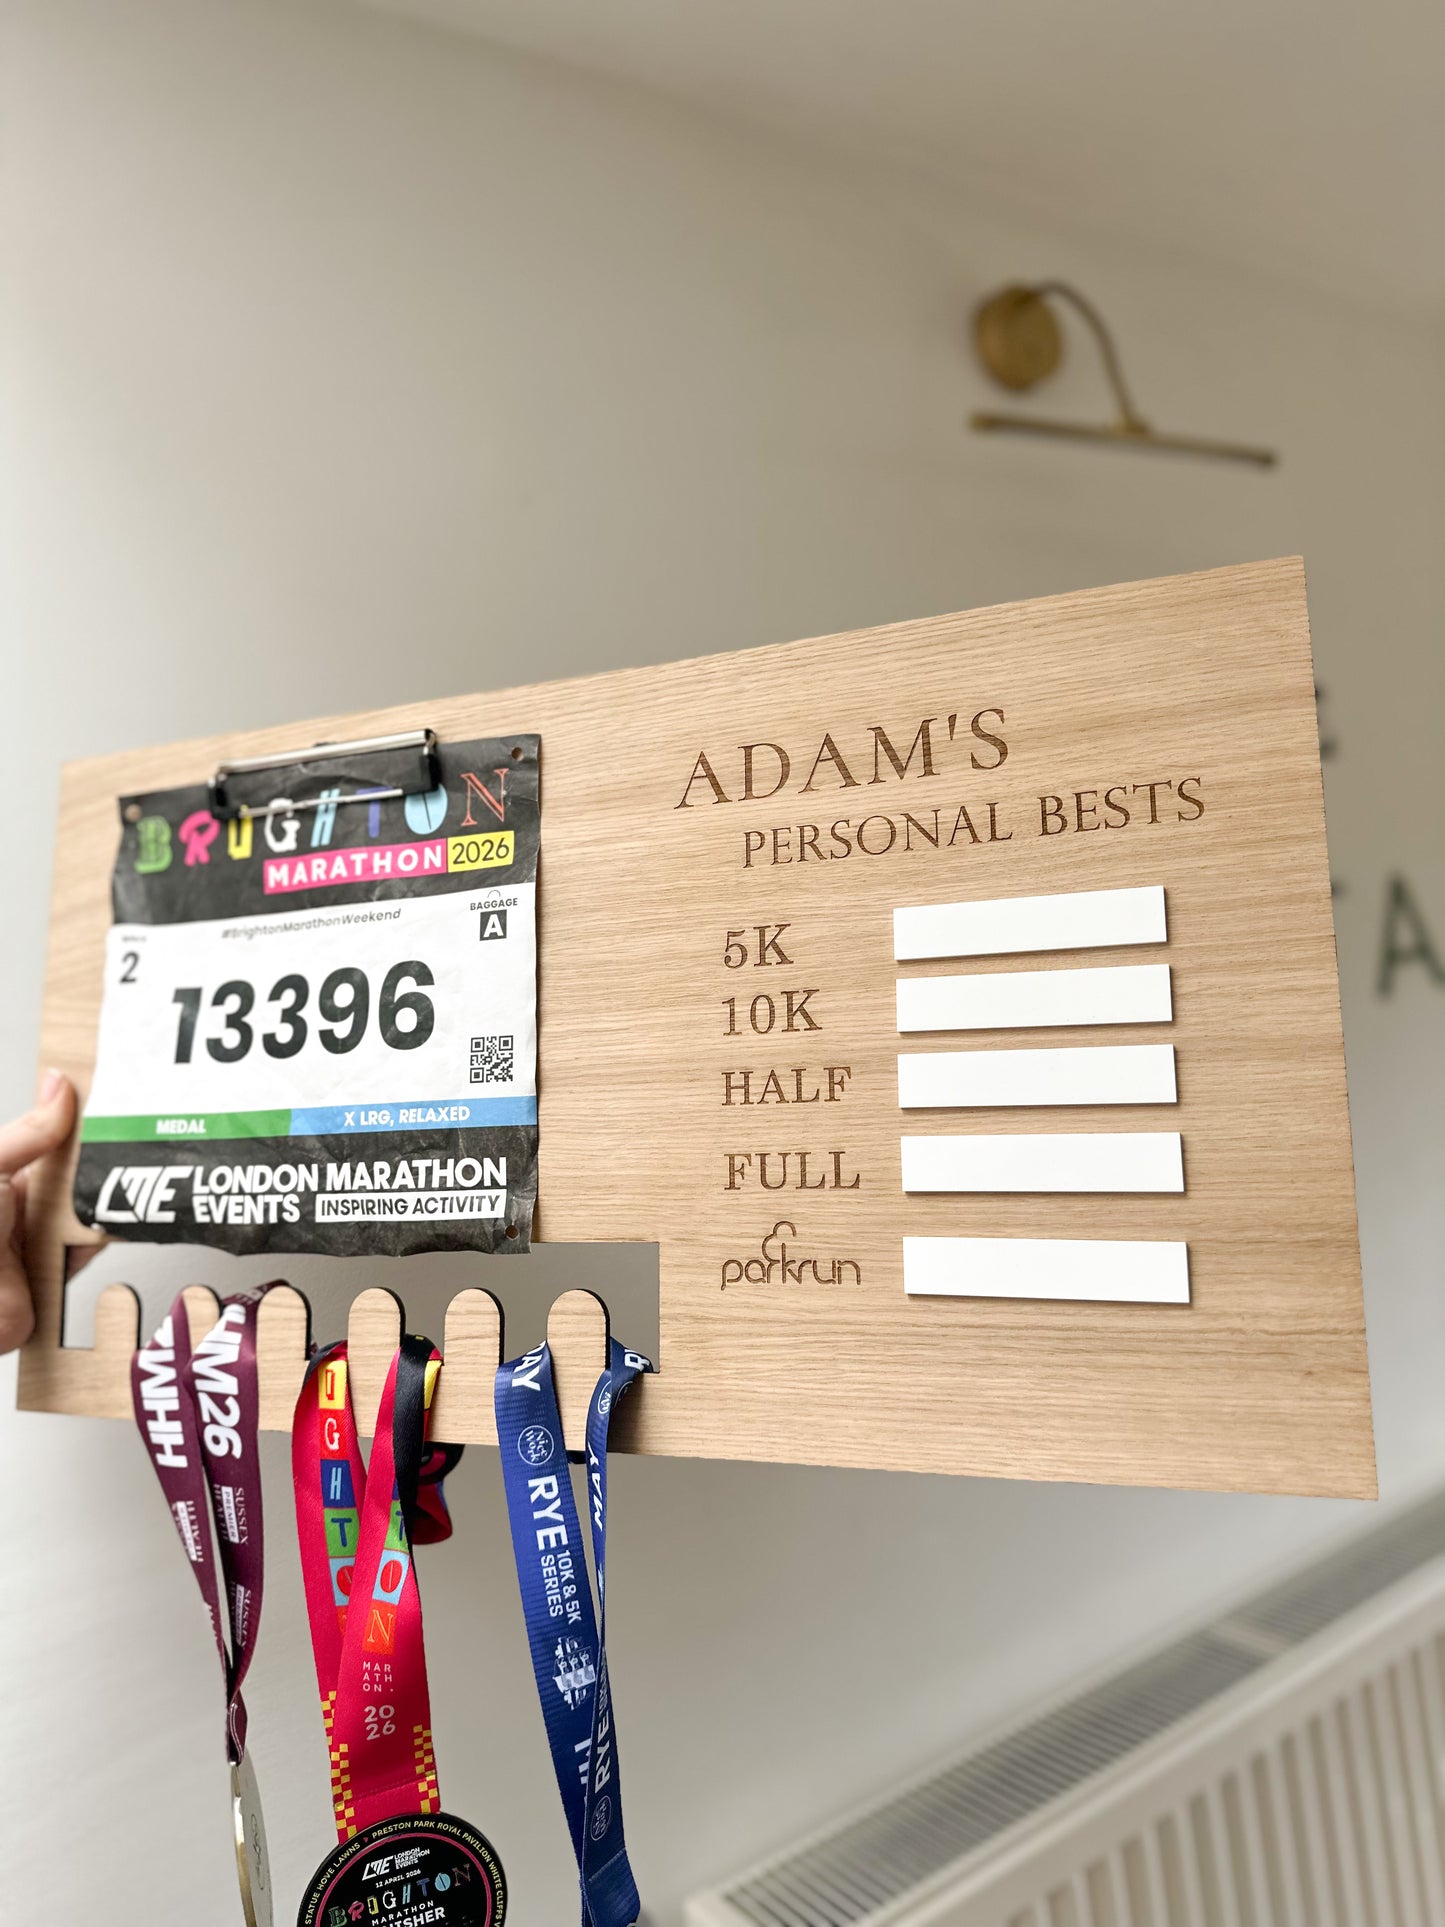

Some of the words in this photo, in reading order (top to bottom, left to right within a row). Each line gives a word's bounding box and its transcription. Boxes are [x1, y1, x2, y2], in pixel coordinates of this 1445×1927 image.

[674, 708, 1010, 810] ADAM'S
[742, 802, 1013, 868] PERSONAL
[1036, 777, 1206, 837] BESTS
[267, 845, 443, 889] MARATHON
[452, 838, 510, 865] 2026
[470, 898, 518, 911] BAGGAGE
[483, 914, 504, 938] A
[722, 923, 795, 969] 5K
[120, 950, 140, 984] 2
[172, 960, 435, 1064] 13396
[721, 988, 823, 1036] 10K
[721, 1066, 852, 1106] HALF
[156, 1118, 206, 1135] MEDAL
[344, 1111, 355, 1127] X
[360, 1110, 394, 1127] LRG,
[399, 1106, 470, 1123] RELAXED
[193, 1163, 319, 1195] LONDON
[325, 1157, 507, 1191] MARATHON
[723, 1151, 861, 1191] FULL
[193, 1193, 301, 1224] EVENTS
[321, 1198, 409, 1216] INSPIRING
[412, 1194, 501, 1214] ACTIVITY
[721, 1231, 861, 1290] parkrun
[525, 1430, 542, 1462] Work
[535, 1429, 549, 1458] Nice
[587, 1441, 603, 1532] MAY
[224, 1490, 237, 1540] PREMIER
[235, 1487, 248, 1545] SUSSEX
[528, 1475, 569, 1551] RYE
[556, 1549, 575, 1582] 10K
[540, 1554, 564, 1618] SERIES
[562, 1583, 577, 1599] &
[565, 1600, 582, 1625] 5K
[362, 1660, 392, 1673] MAR
[362, 1671, 393, 1683] ATH
[363, 1704, 396, 1723] 20
[366, 1720, 396, 1741] 26
[595, 1711, 611, 1794] RYE
[371, 1821, 411, 1839] PRESTON
[413, 1820, 435, 1829] PARK
[437, 1822, 462, 1837] ROYAL
[462, 1832, 493, 1863] PAVILION
[488, 1861, 503, 1890] WHITE
[496, 1890, 504, 1920] CLIFFS
[394, 1846, 421, 1860] LONDON
[304, 1891, 320, 1925] STATUE
[317, 1867, 335, 1891] HOVE
[333, 1842, 361, 1868] LAWNS
[328, 1862, 472, 1927] BRIGHTON
[375, 1881, 384, 1889] 12
[384, 1874, 405, 1886] APRIL
[405, 1868, 422, 1879] 2026
[371, 1900, 434, 1927] MARATHON
